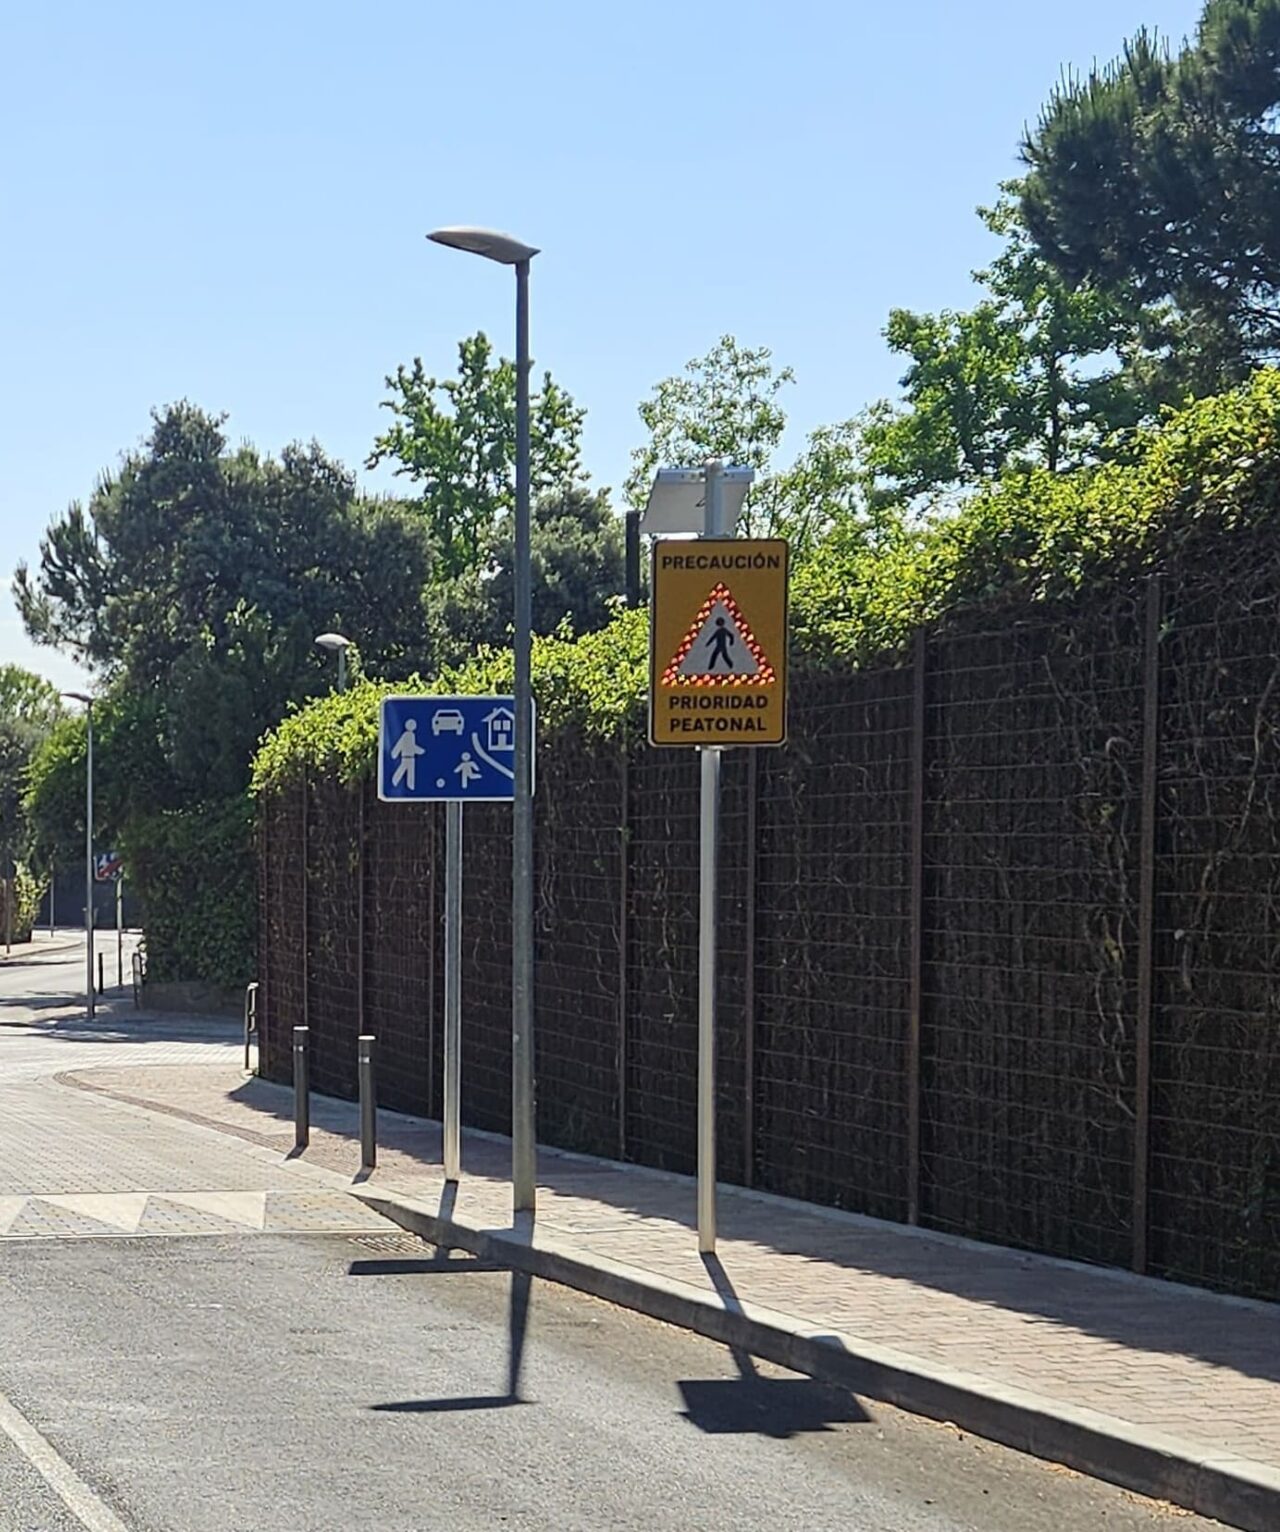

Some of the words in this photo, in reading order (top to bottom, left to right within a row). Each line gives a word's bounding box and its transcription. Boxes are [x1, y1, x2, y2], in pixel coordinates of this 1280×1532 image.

[662, 552, 780, 569] PRECAUCIÓN
[669, 695, 768, 709] PRIORIDAD
[670, 717, 767, 732] PEATONAL
